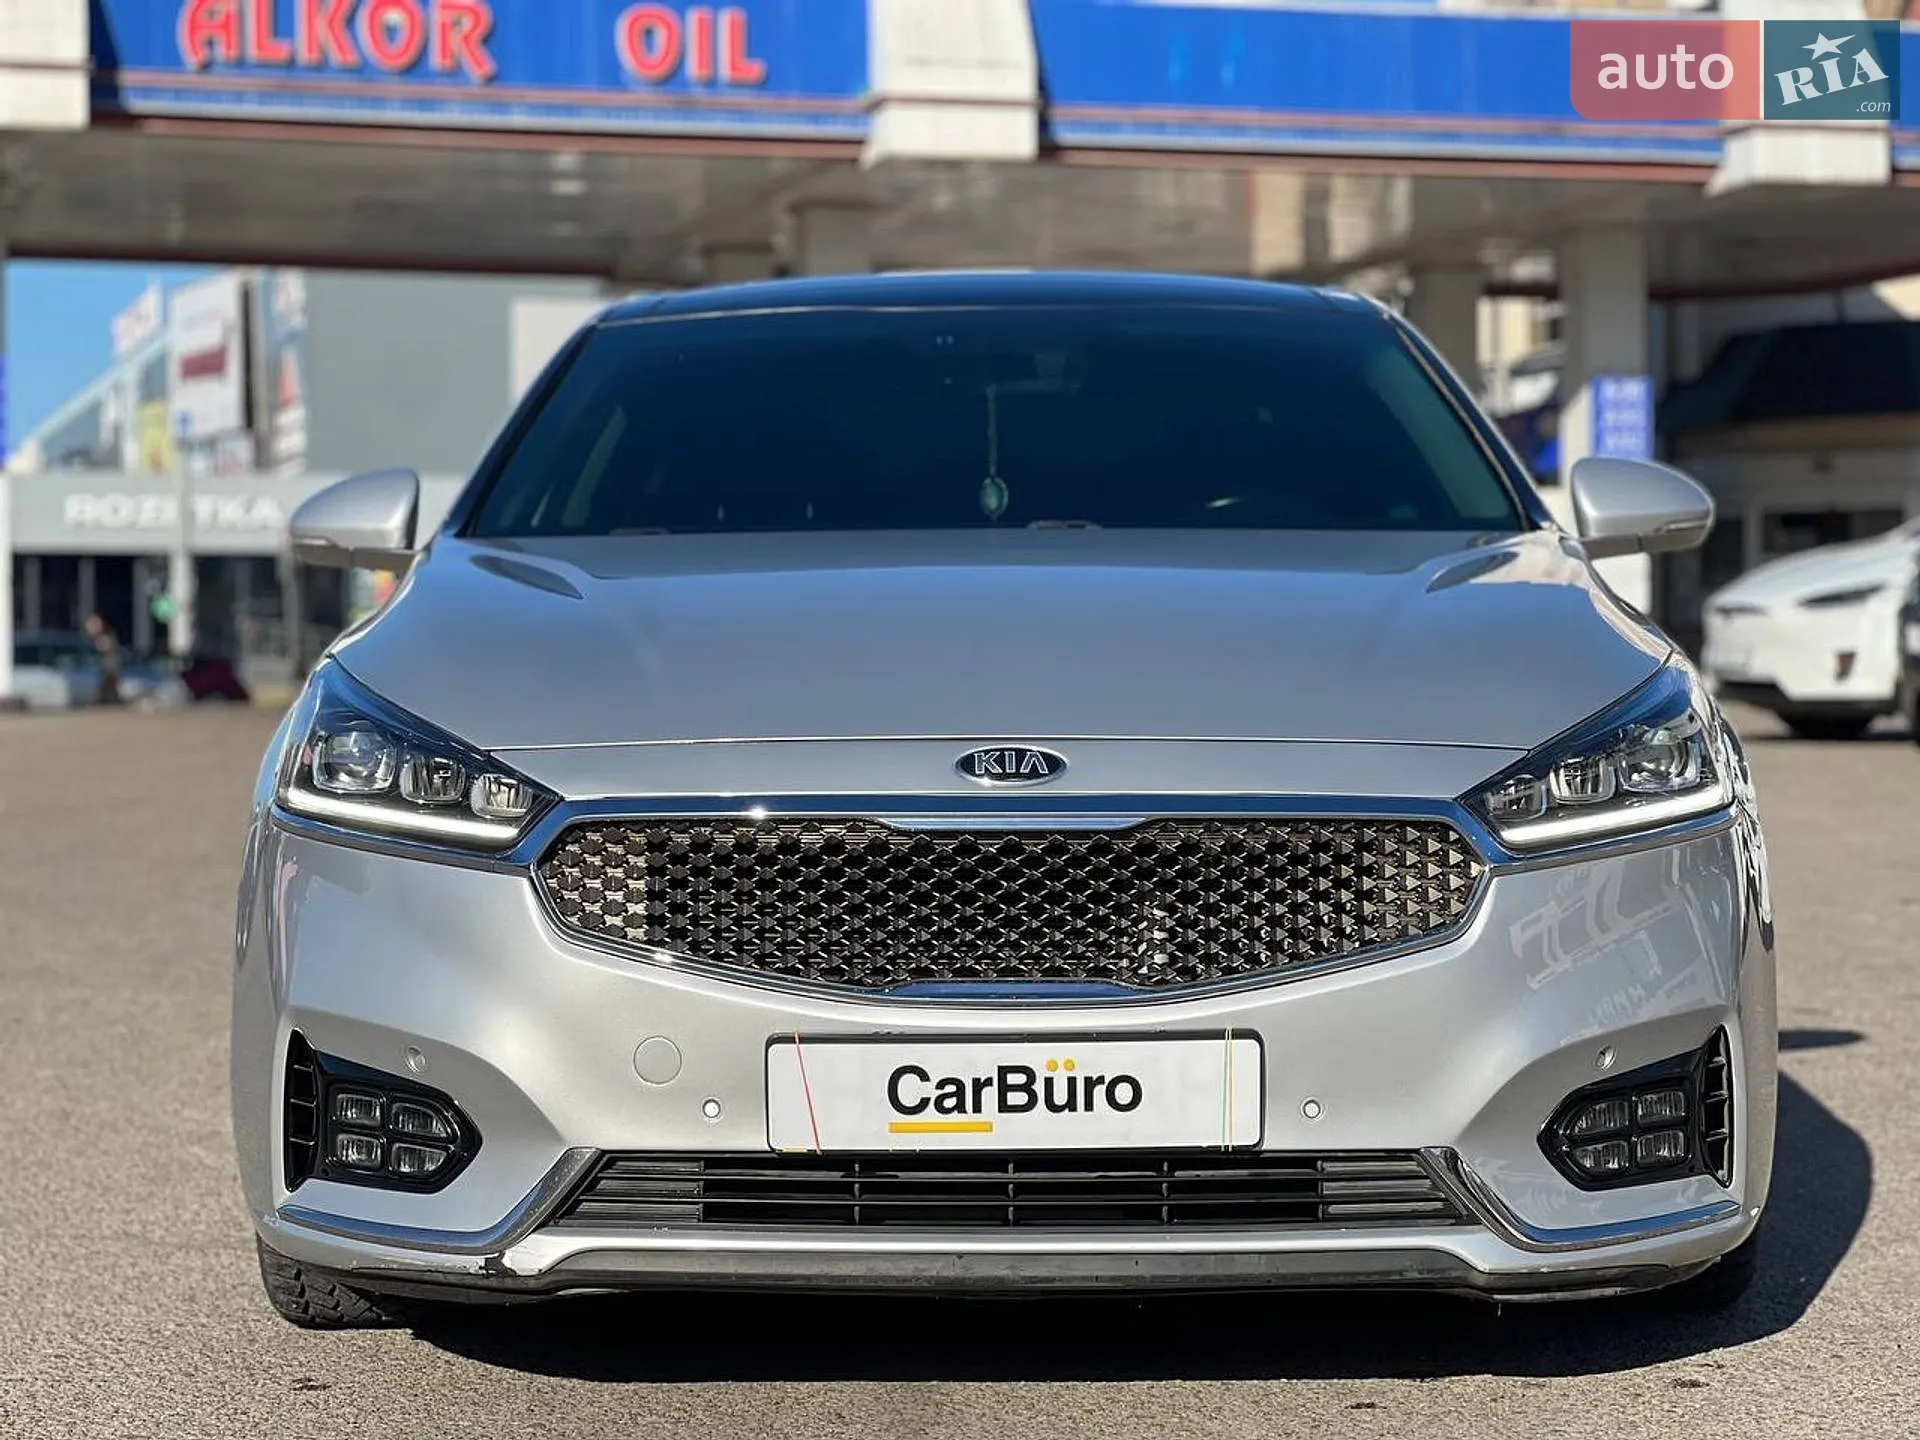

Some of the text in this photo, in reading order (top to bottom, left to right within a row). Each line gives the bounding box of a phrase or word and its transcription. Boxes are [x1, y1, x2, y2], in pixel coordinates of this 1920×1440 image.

[178, 0, 768, 84] ALKOR OIL
[974, 751, 1049, 774] KIA
[886, 1058, 1143, 1115] CarBüro
